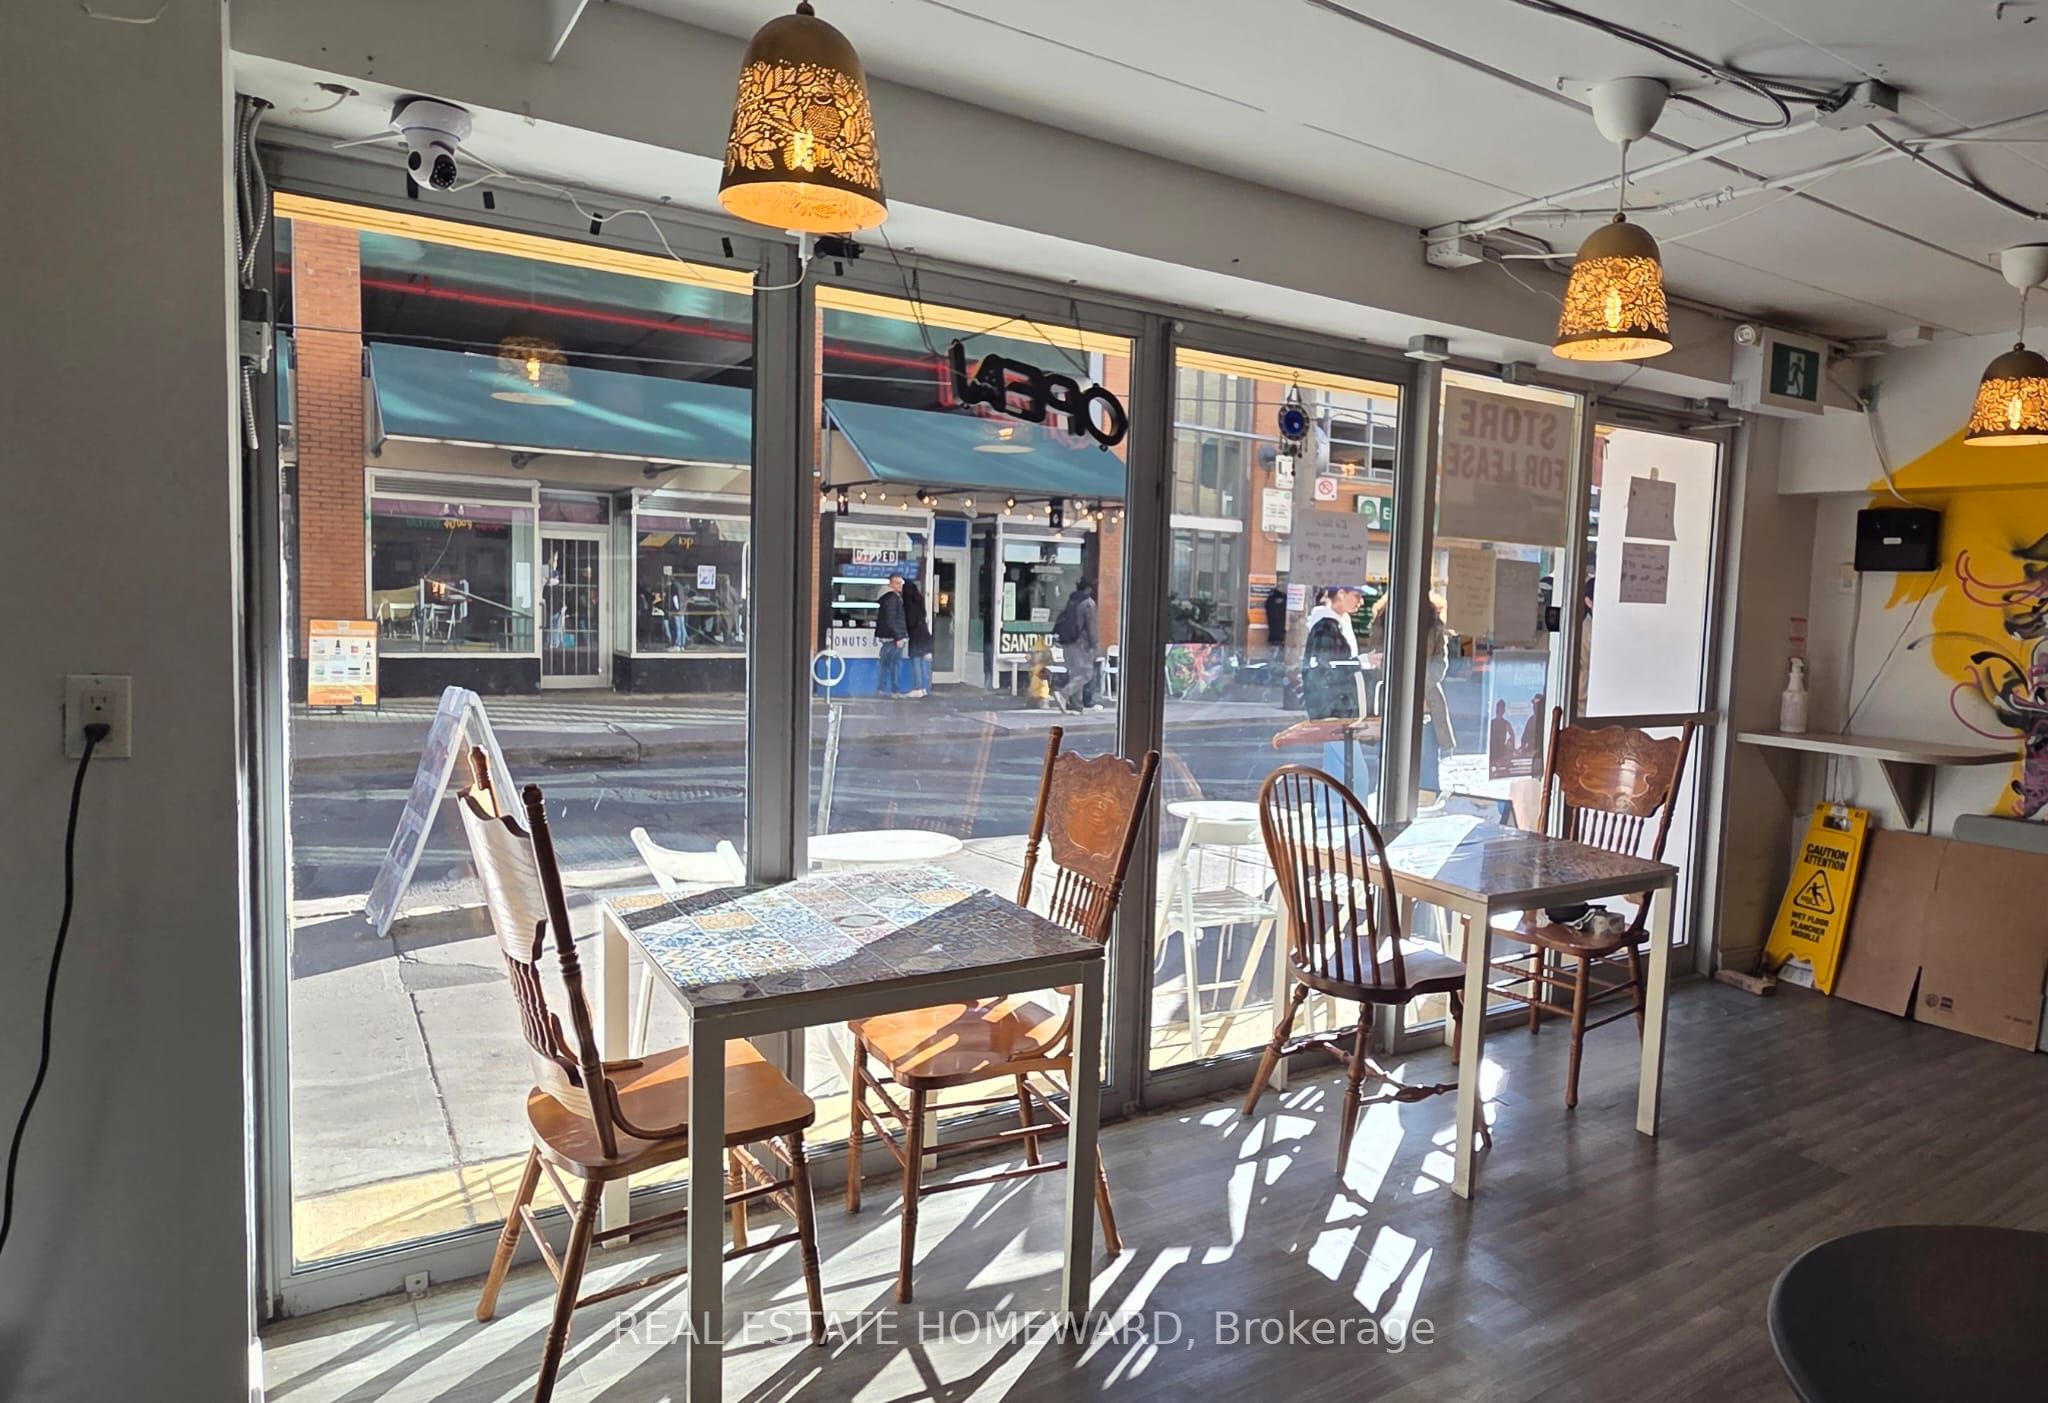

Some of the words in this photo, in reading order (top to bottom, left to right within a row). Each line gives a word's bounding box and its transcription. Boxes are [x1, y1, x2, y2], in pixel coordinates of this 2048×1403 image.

[856, 550, 895, 563] DIPPED
[834, 635, 868, 648] ONUTS
[1806, 843, 1849, 862] CAUTION
[1803, 854, 1846, 872] ATTENTION
